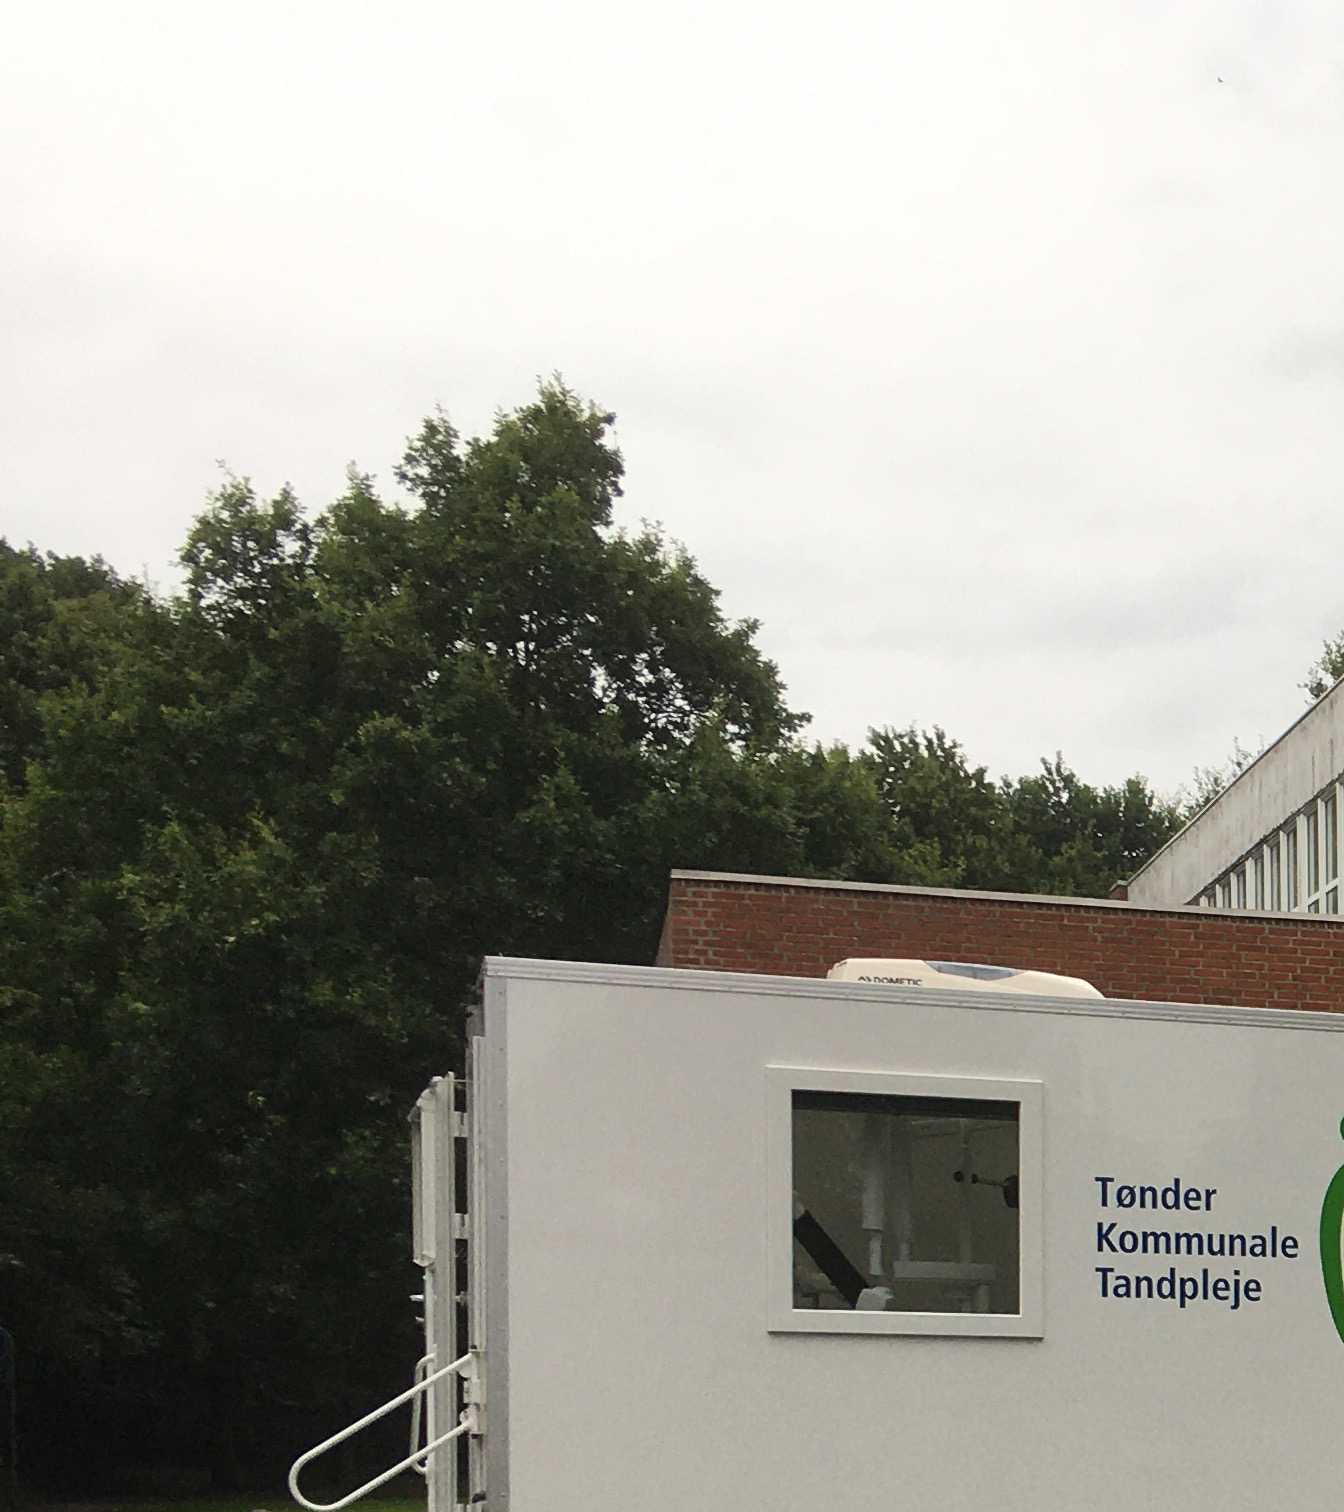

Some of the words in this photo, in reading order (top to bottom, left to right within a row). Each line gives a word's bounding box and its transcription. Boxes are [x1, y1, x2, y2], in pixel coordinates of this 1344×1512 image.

[1095, 1176, 1217, 1212] Tønder
[1096, 1222, 1299, 1259] Kommunale
[1095, 1267, 1262, 1310] Tandpleje
